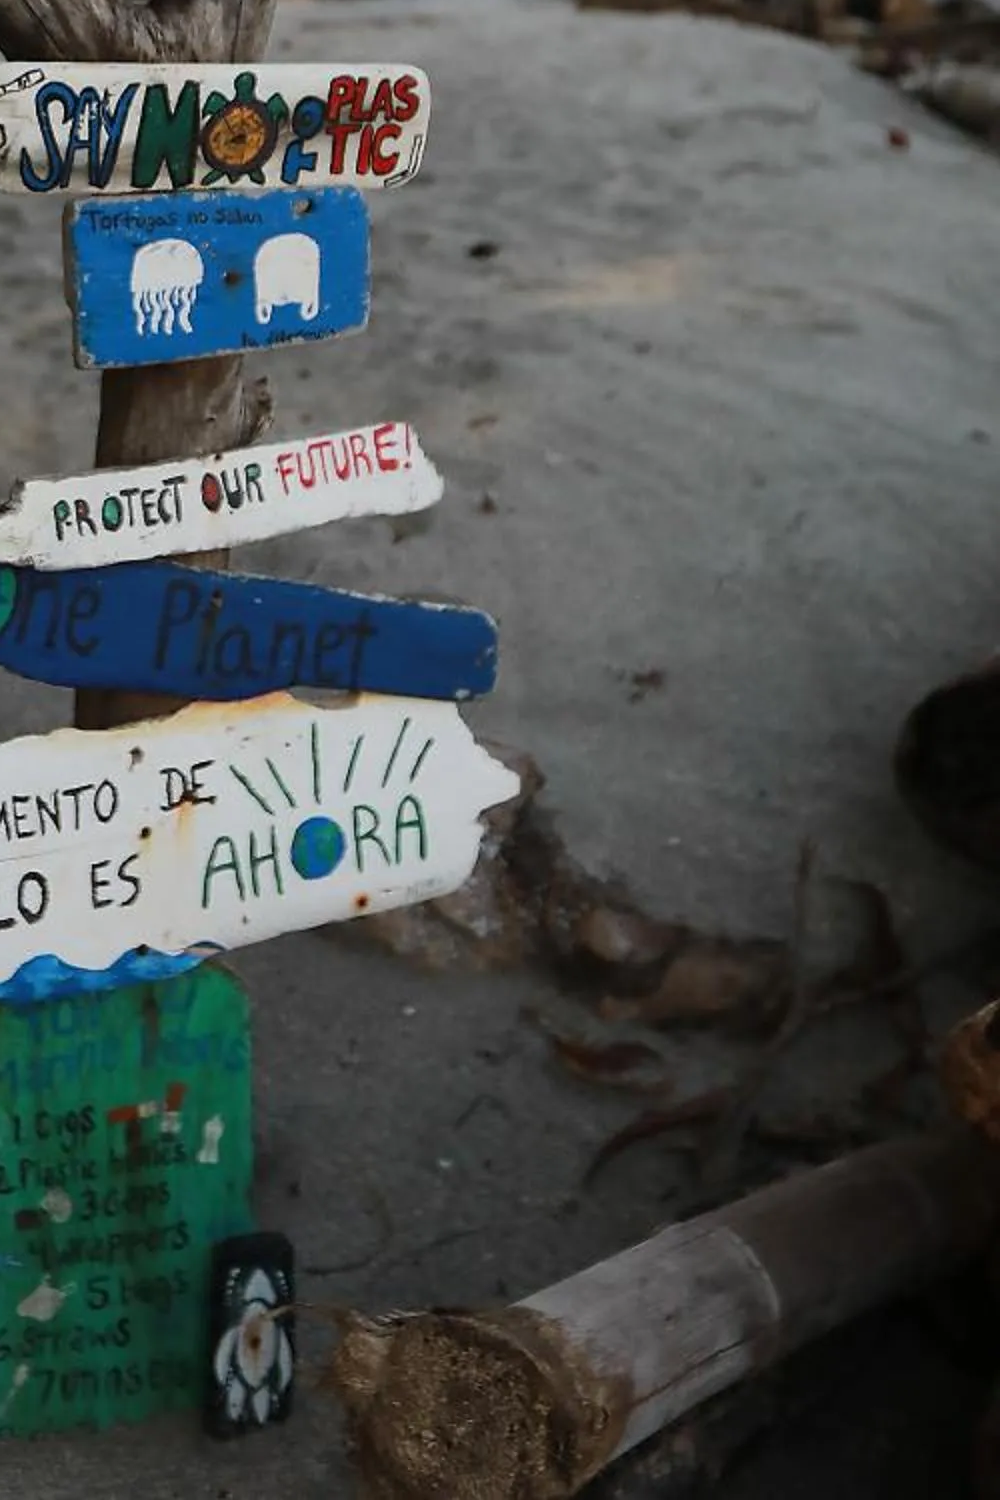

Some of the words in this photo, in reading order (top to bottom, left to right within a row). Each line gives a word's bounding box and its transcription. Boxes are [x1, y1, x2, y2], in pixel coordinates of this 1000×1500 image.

[19, 81, 141, 192] SAY
[327, 74, 421, 123] PLAS
[326, 123, 403, 177] TIC
[187, 208, 210, 227] no
[53, 474, 187, 541] PROTECT
[200, 461, 265, 513] OUR
[276, 421, 418, 496] FUTURE!
[153, 578, 380, 692] Planet
[159, 758, 219, 813] DE
[90, 853, 142, 911] ES
[200, 794, 429, 909] AHORA
